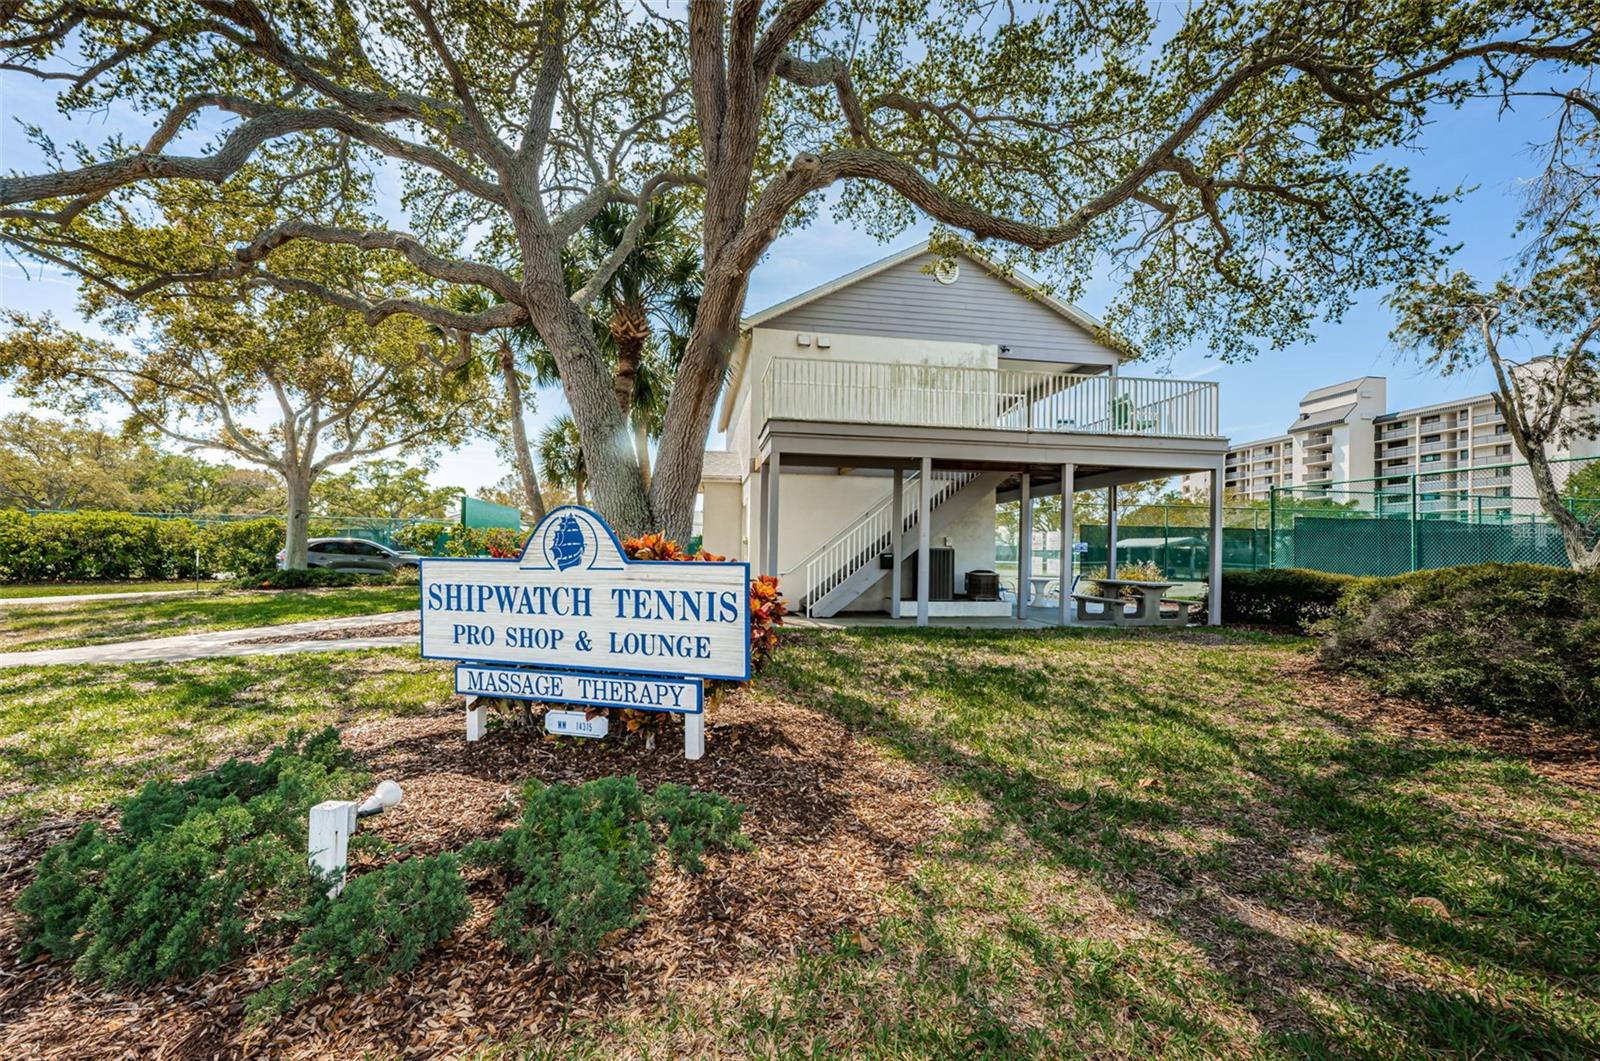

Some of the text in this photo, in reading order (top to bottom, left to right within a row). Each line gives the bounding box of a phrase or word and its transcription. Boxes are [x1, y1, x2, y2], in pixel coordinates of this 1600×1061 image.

[428, 583, 738, 623] SHIPWATCH TENNIS
[453, 624, 711, 658] PRO SHOP & LOUNGE
[467, 671, 685, 707] MASSAGE THERAPY
